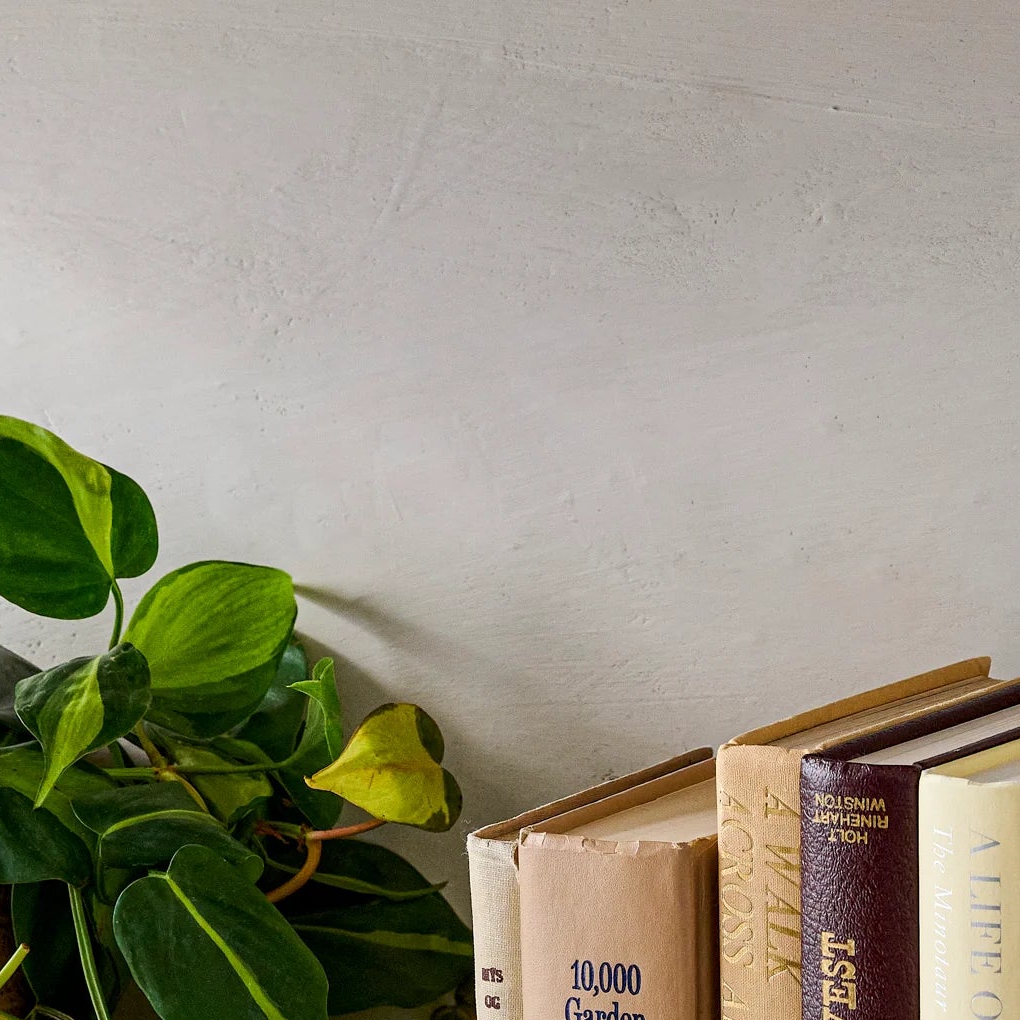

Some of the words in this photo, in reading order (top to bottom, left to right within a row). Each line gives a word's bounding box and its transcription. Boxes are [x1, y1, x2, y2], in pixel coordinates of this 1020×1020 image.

[812, 810, 889, 829] RINEHART
[814, 792, 886, 812] WINSTON
[828, 828, 868, 844] HOLT
[932, 825, 954, 875] The
[969, 828, 1002, 857] A
[765, 844, 802, 986] WALK
[969, 871, 1002, 975] LIFE
[933, 884, 954, 1012] Minotaur
[570, 959, 642, 997] 10,000
